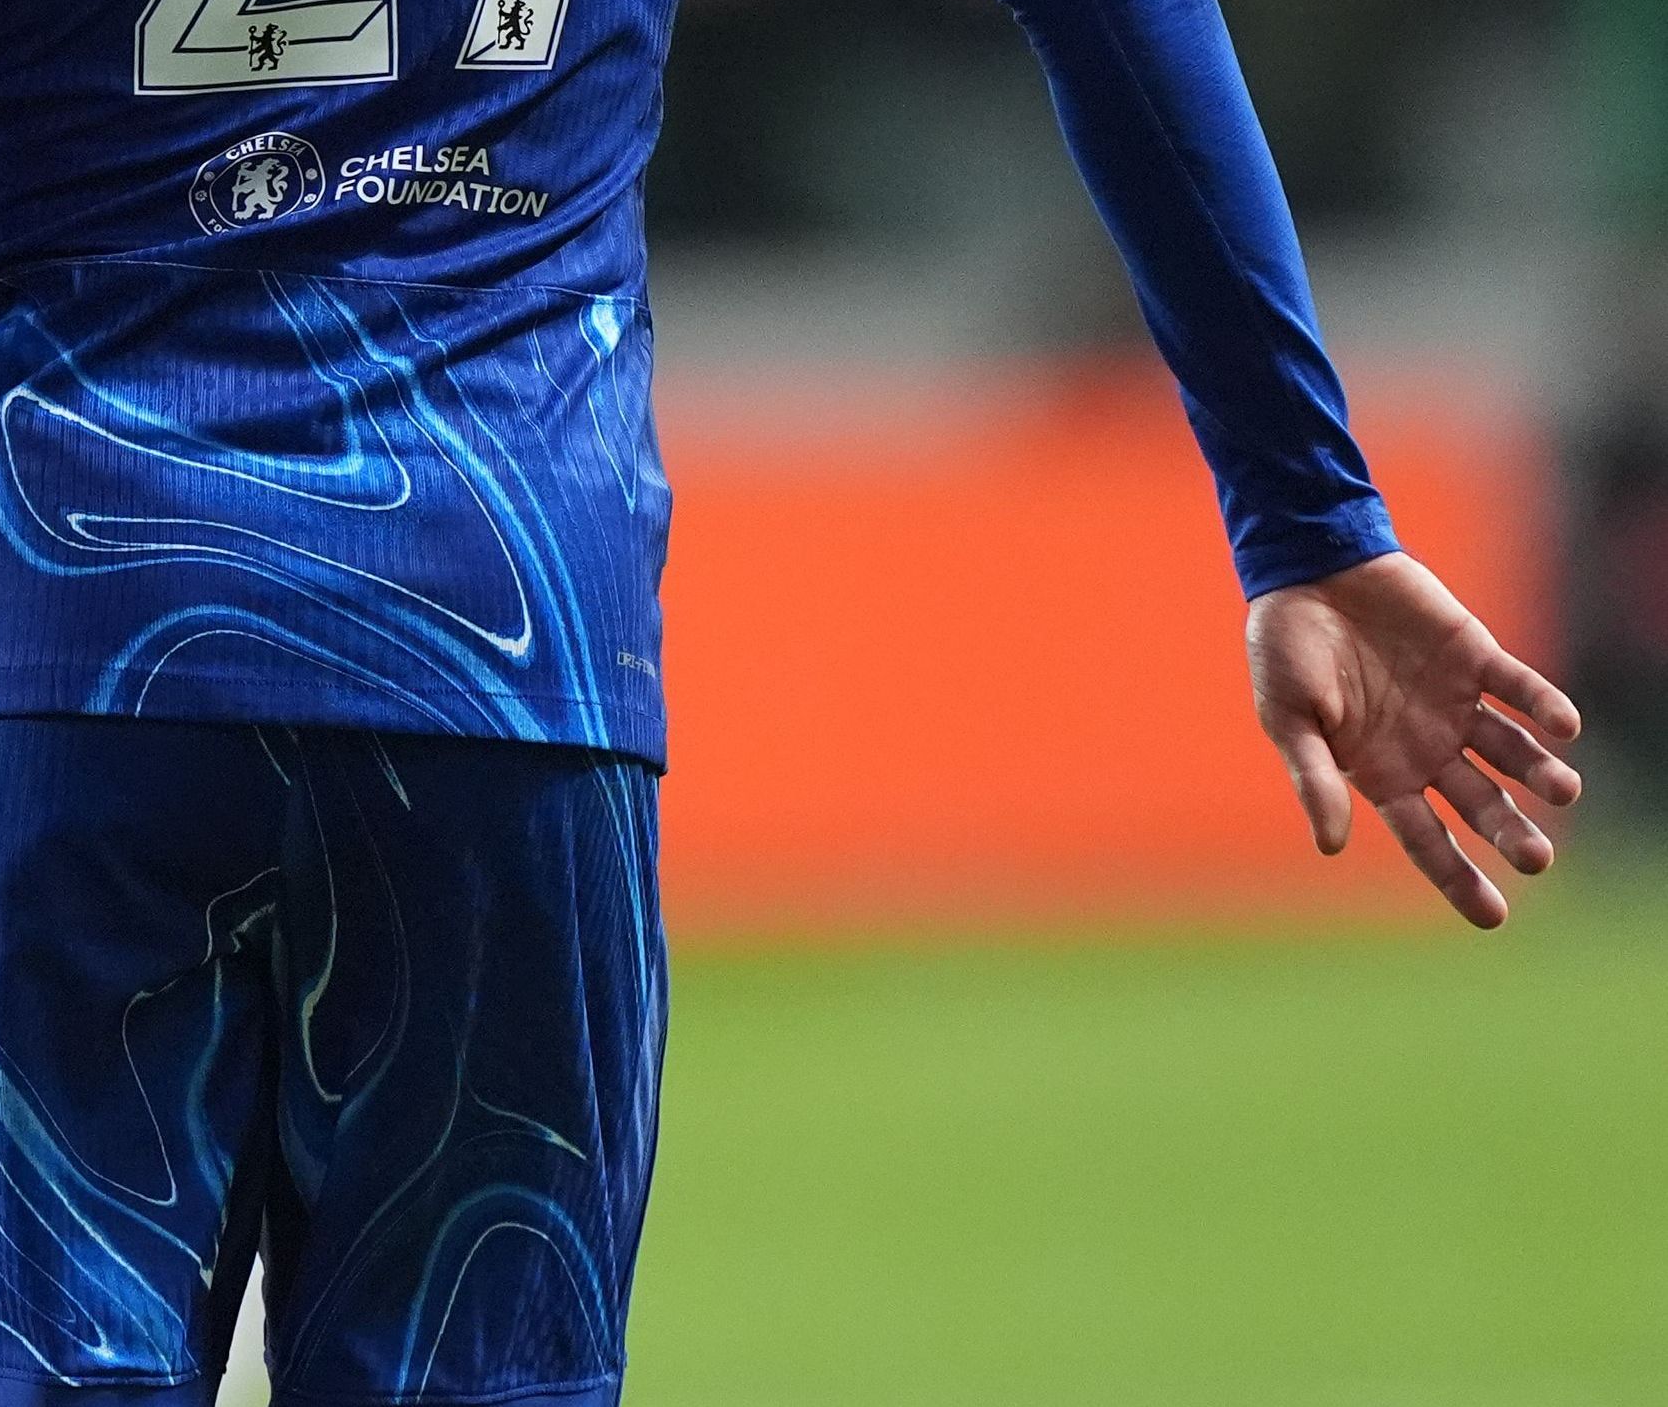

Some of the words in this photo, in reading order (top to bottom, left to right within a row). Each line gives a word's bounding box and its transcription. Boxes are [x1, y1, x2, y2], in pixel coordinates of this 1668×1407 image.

[225, 135, 307, 160] CHELSEA
[340, 145, 491, 177] CHELSEA
[334, 175, 549, 218] FOUNDATION
